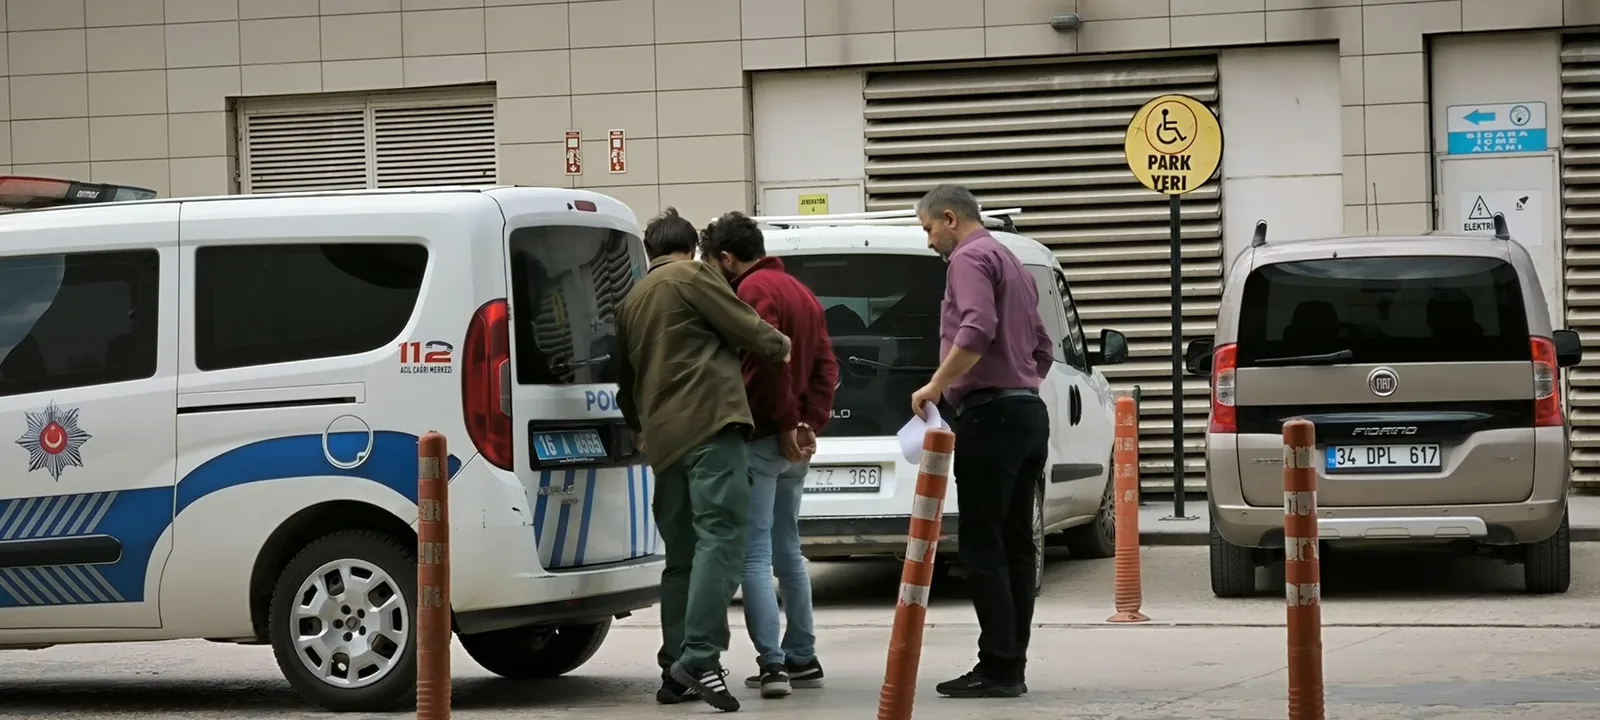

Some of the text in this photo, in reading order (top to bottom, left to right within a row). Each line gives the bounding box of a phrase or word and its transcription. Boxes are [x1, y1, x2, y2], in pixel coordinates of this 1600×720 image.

[1148, 154, 1191, 170] PARK
[398, 340, 453, 363] 112
[1376, 377, 1392, 389] FIAT
[1352, 426, 1418, 436] FIORINO
[539, 432, 602, 456] 16 A 8565
[1337, 446, 1438, 465] 34 DPL 617
[849, 468, 877, 485] 366
